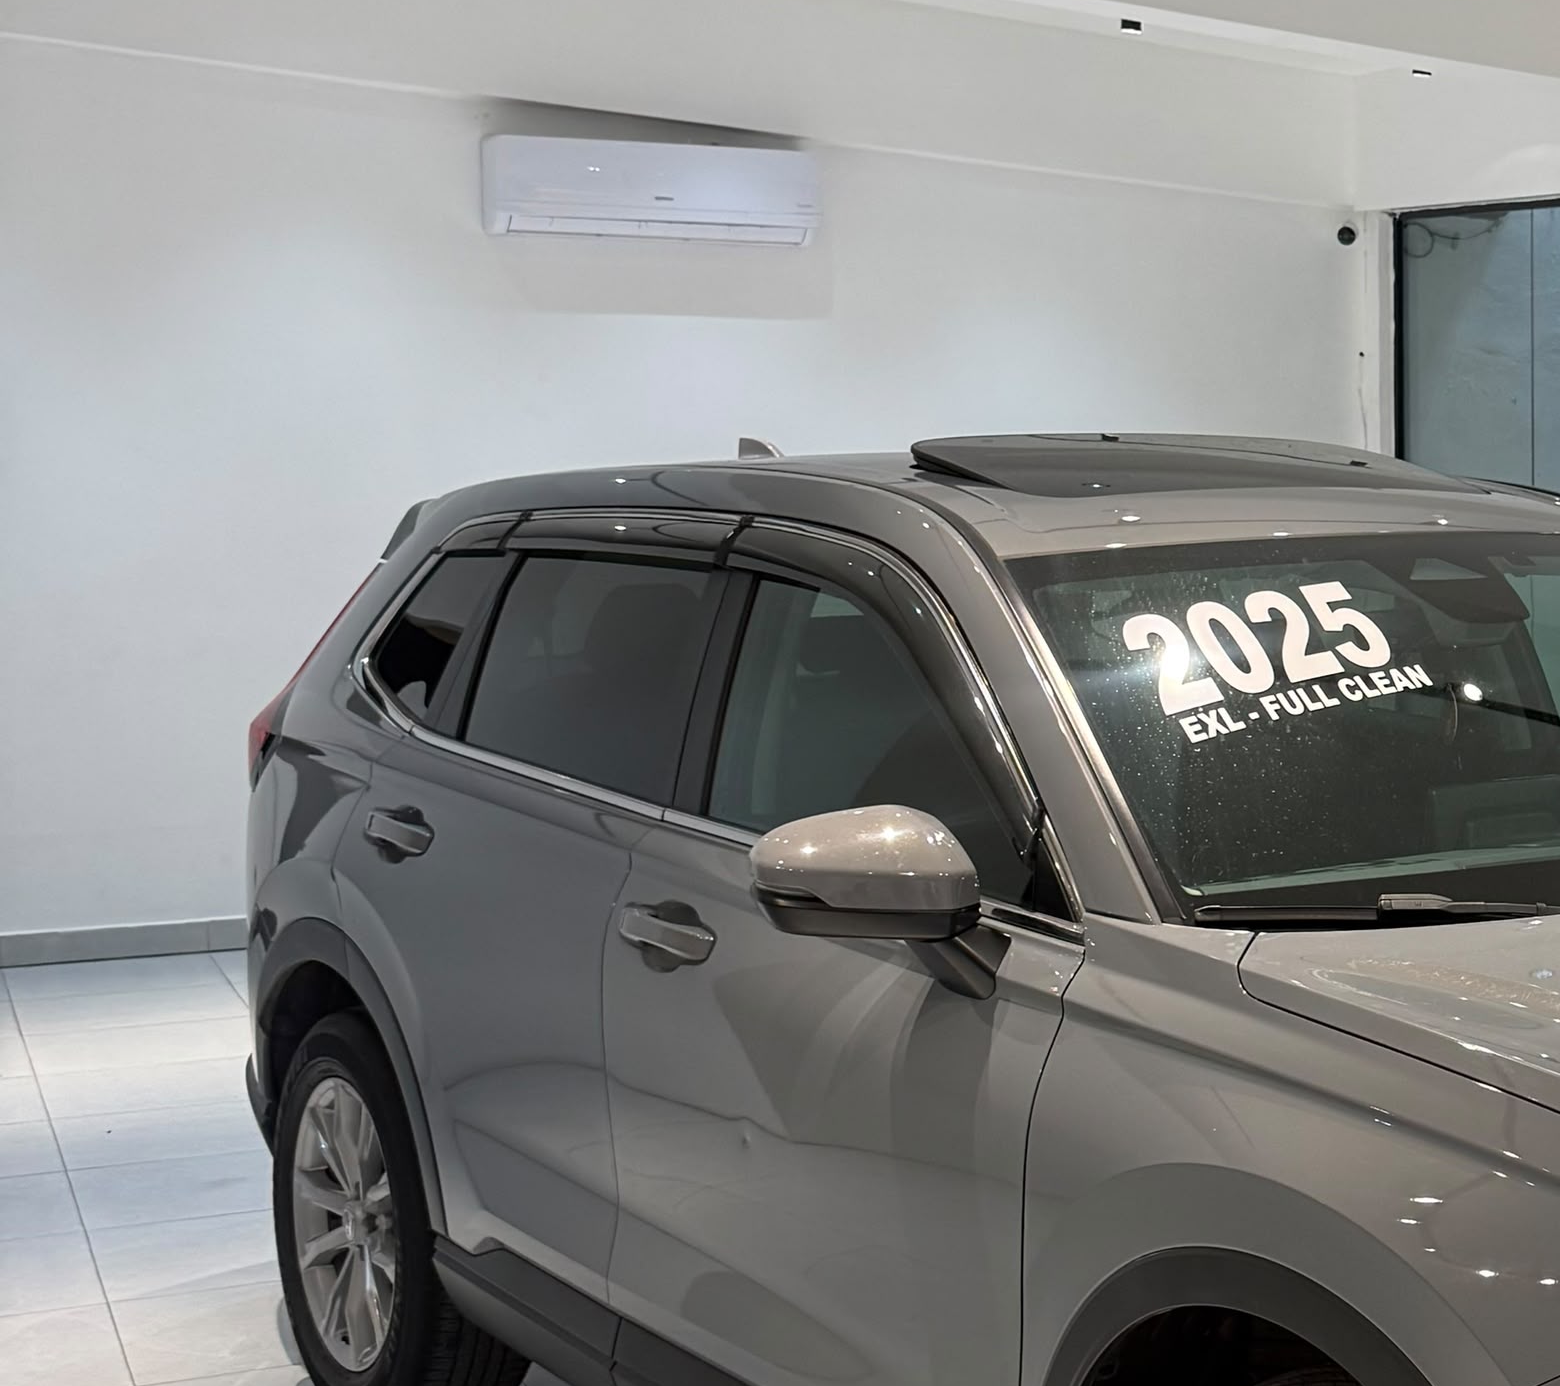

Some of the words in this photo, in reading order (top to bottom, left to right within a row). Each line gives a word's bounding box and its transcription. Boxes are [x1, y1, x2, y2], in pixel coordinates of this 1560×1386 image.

[1122, 580, 1391, 716] 2025
[1179, 706, 1247, 744] EXL
[1261, 689, 1341, 721] FULL
[1338, 664, 1434, 702] CLEAN
